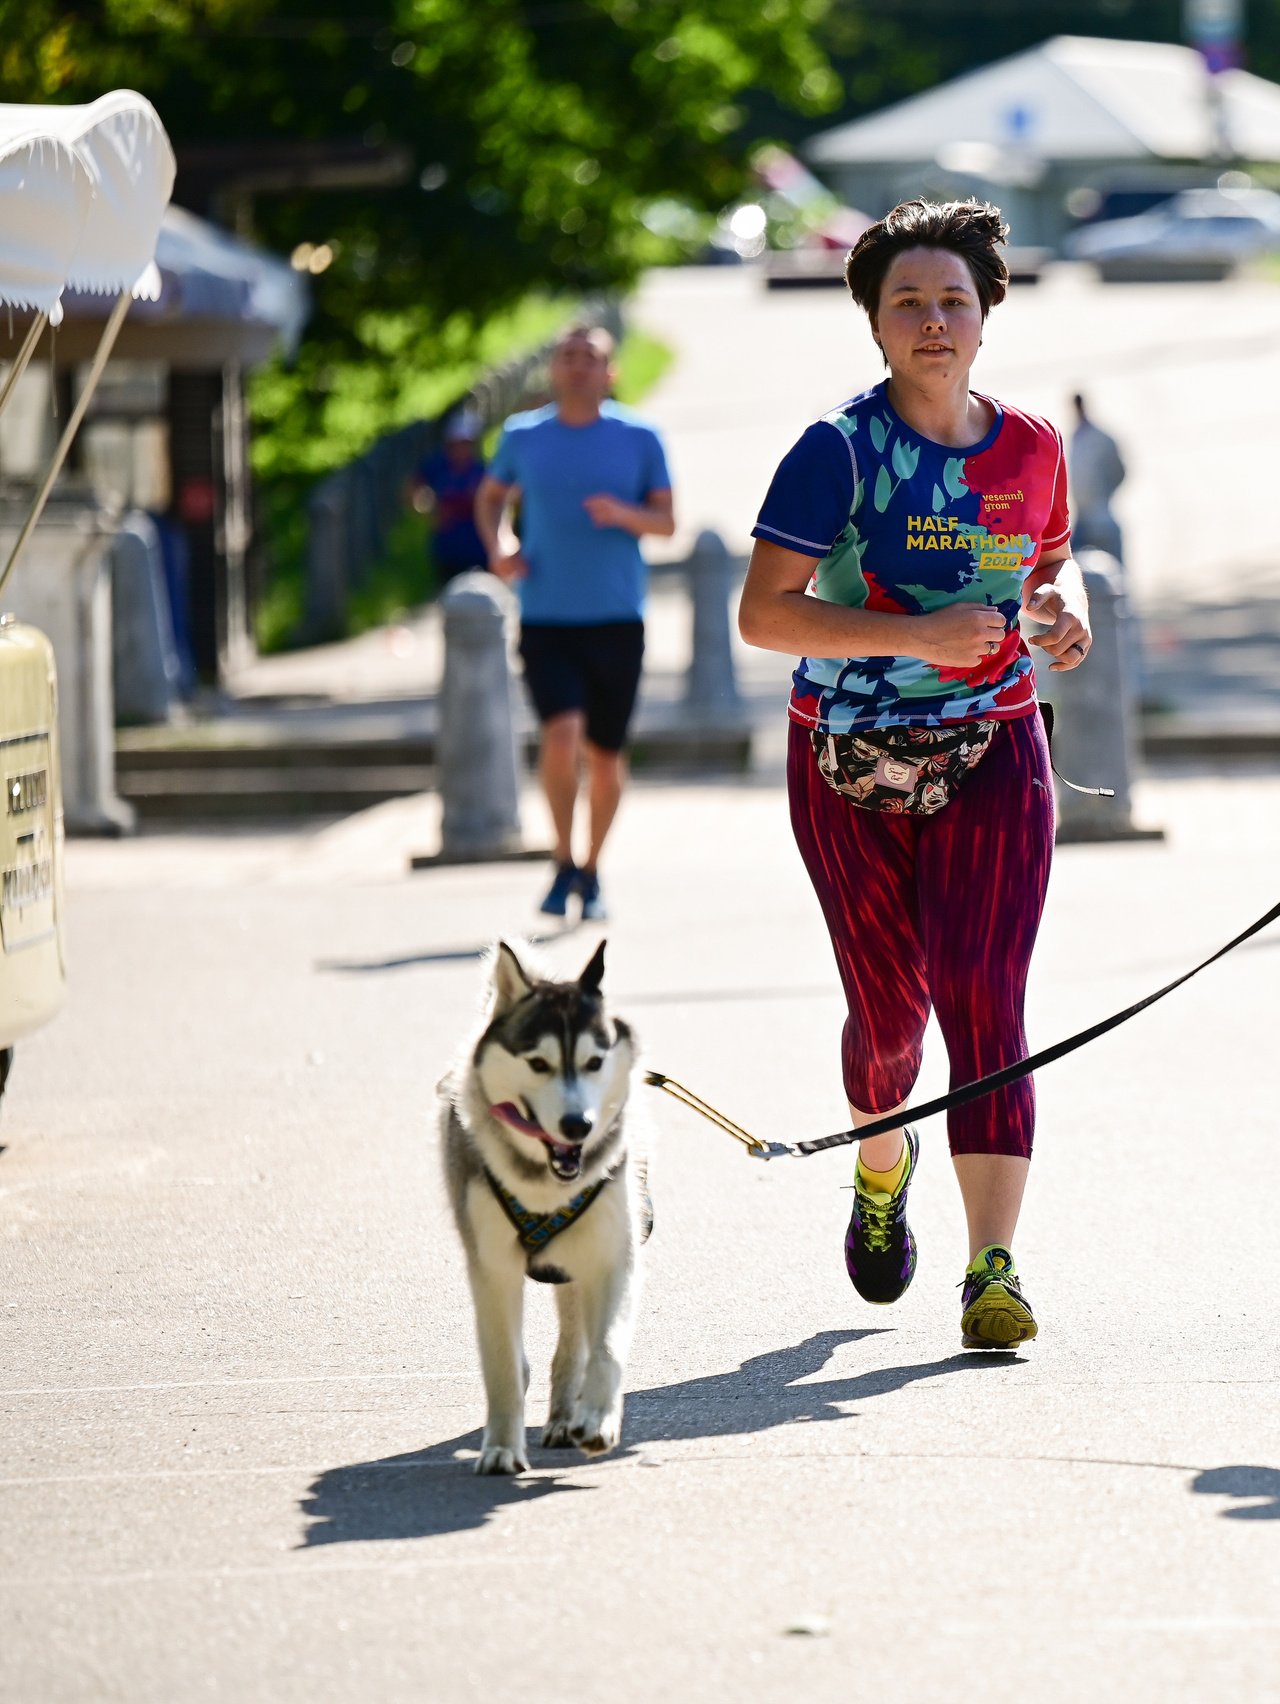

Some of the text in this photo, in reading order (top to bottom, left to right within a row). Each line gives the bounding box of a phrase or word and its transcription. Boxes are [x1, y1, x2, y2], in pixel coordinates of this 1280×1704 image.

[982, 489, 1025, 502] vesennij
[984, 502, 1011, 513] grom
[907, 515, 959, 532] HALF
[906, 533, 1024, 550] MARATHON
[983, 556, 1018, 567] 2018
